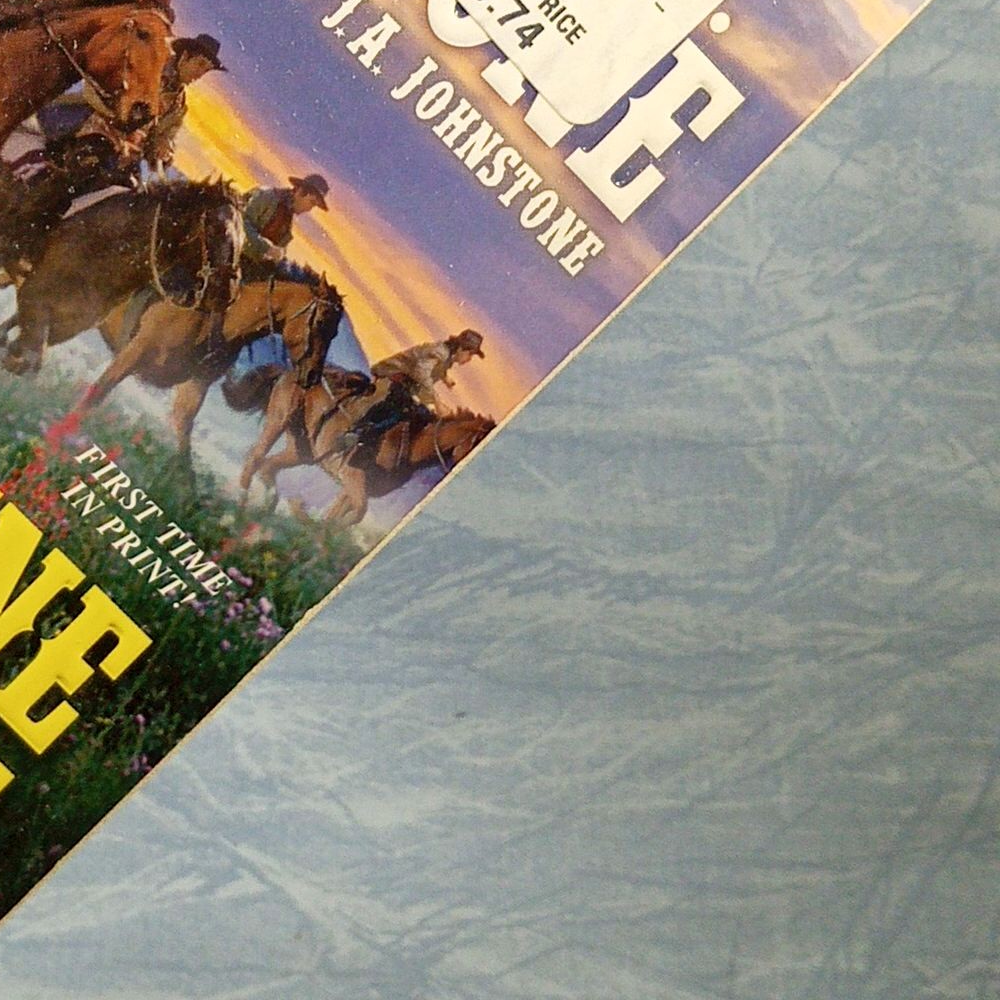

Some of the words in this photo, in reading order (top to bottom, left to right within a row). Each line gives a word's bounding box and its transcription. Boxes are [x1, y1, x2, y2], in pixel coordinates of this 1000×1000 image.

[390, 56, 604, 277] JOHNSTONE
[60, 480, 105, 517] IN
[96, 515, 197, 609] PRINT!
[73, 443, 164, 523] FIRST
[155, 521, 233, 597] TIME
